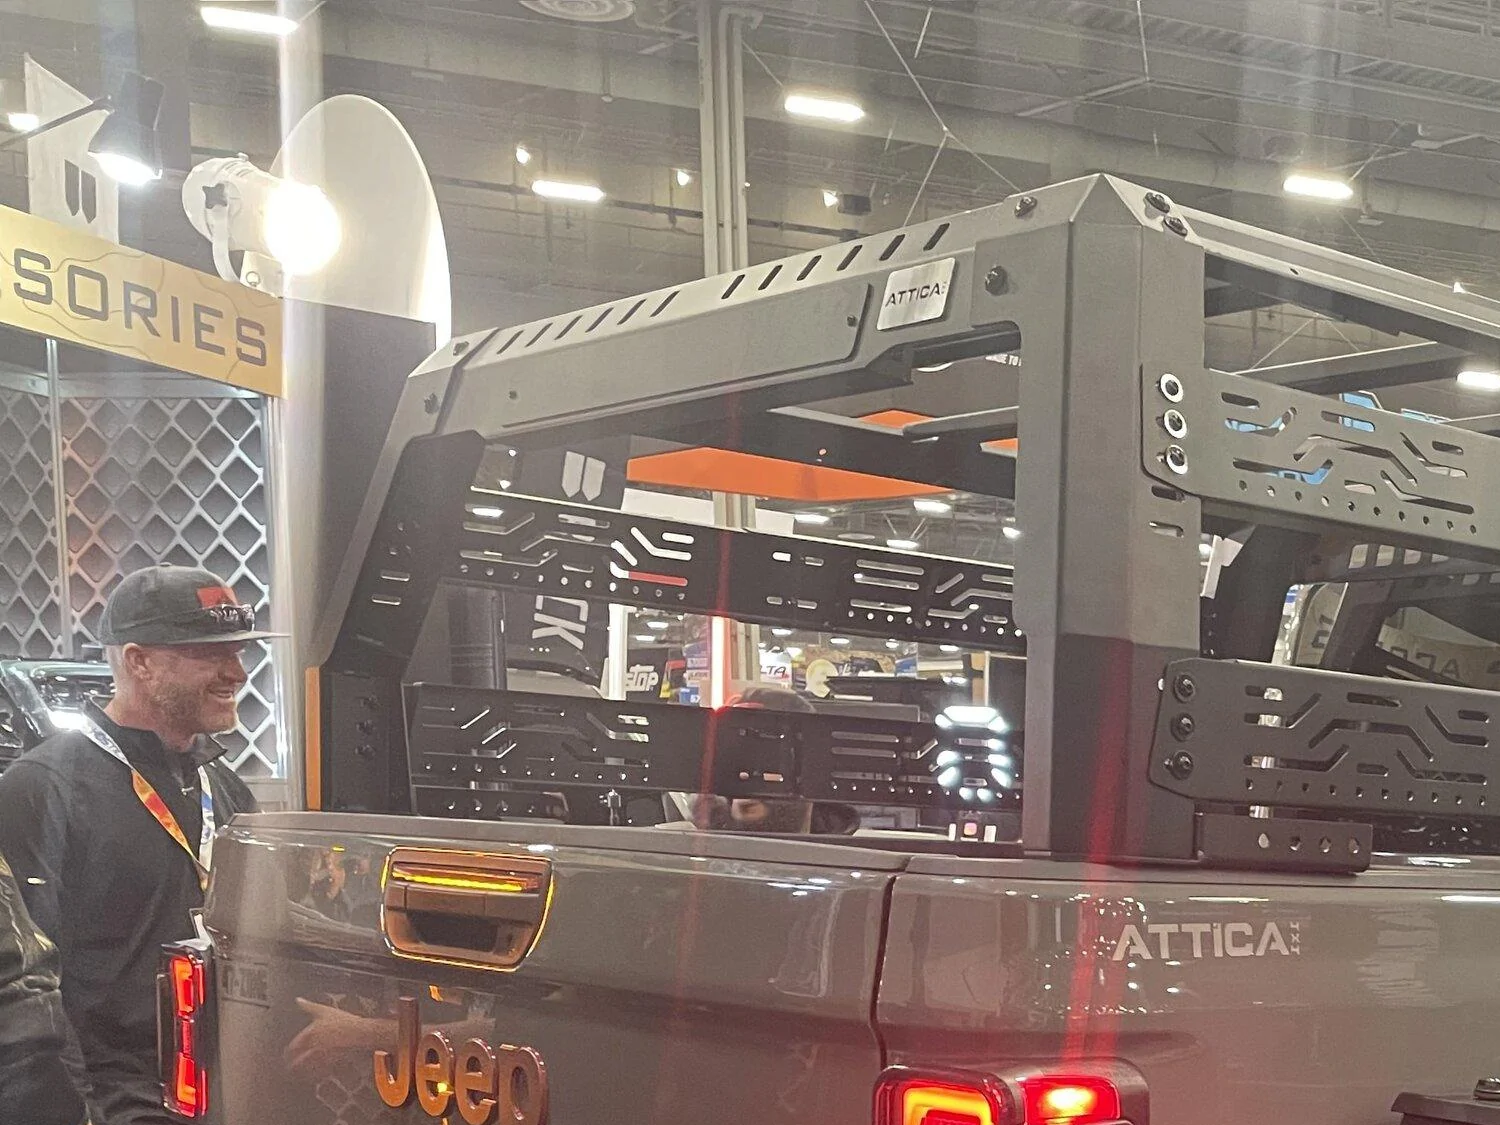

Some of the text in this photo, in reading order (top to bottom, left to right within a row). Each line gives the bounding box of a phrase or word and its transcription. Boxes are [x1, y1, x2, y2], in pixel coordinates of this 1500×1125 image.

[0, 248, 267, 367] SORIES
[885, 283, 941, 308] ATTICA
[1112, 922, 1290, 961] ATTICA
